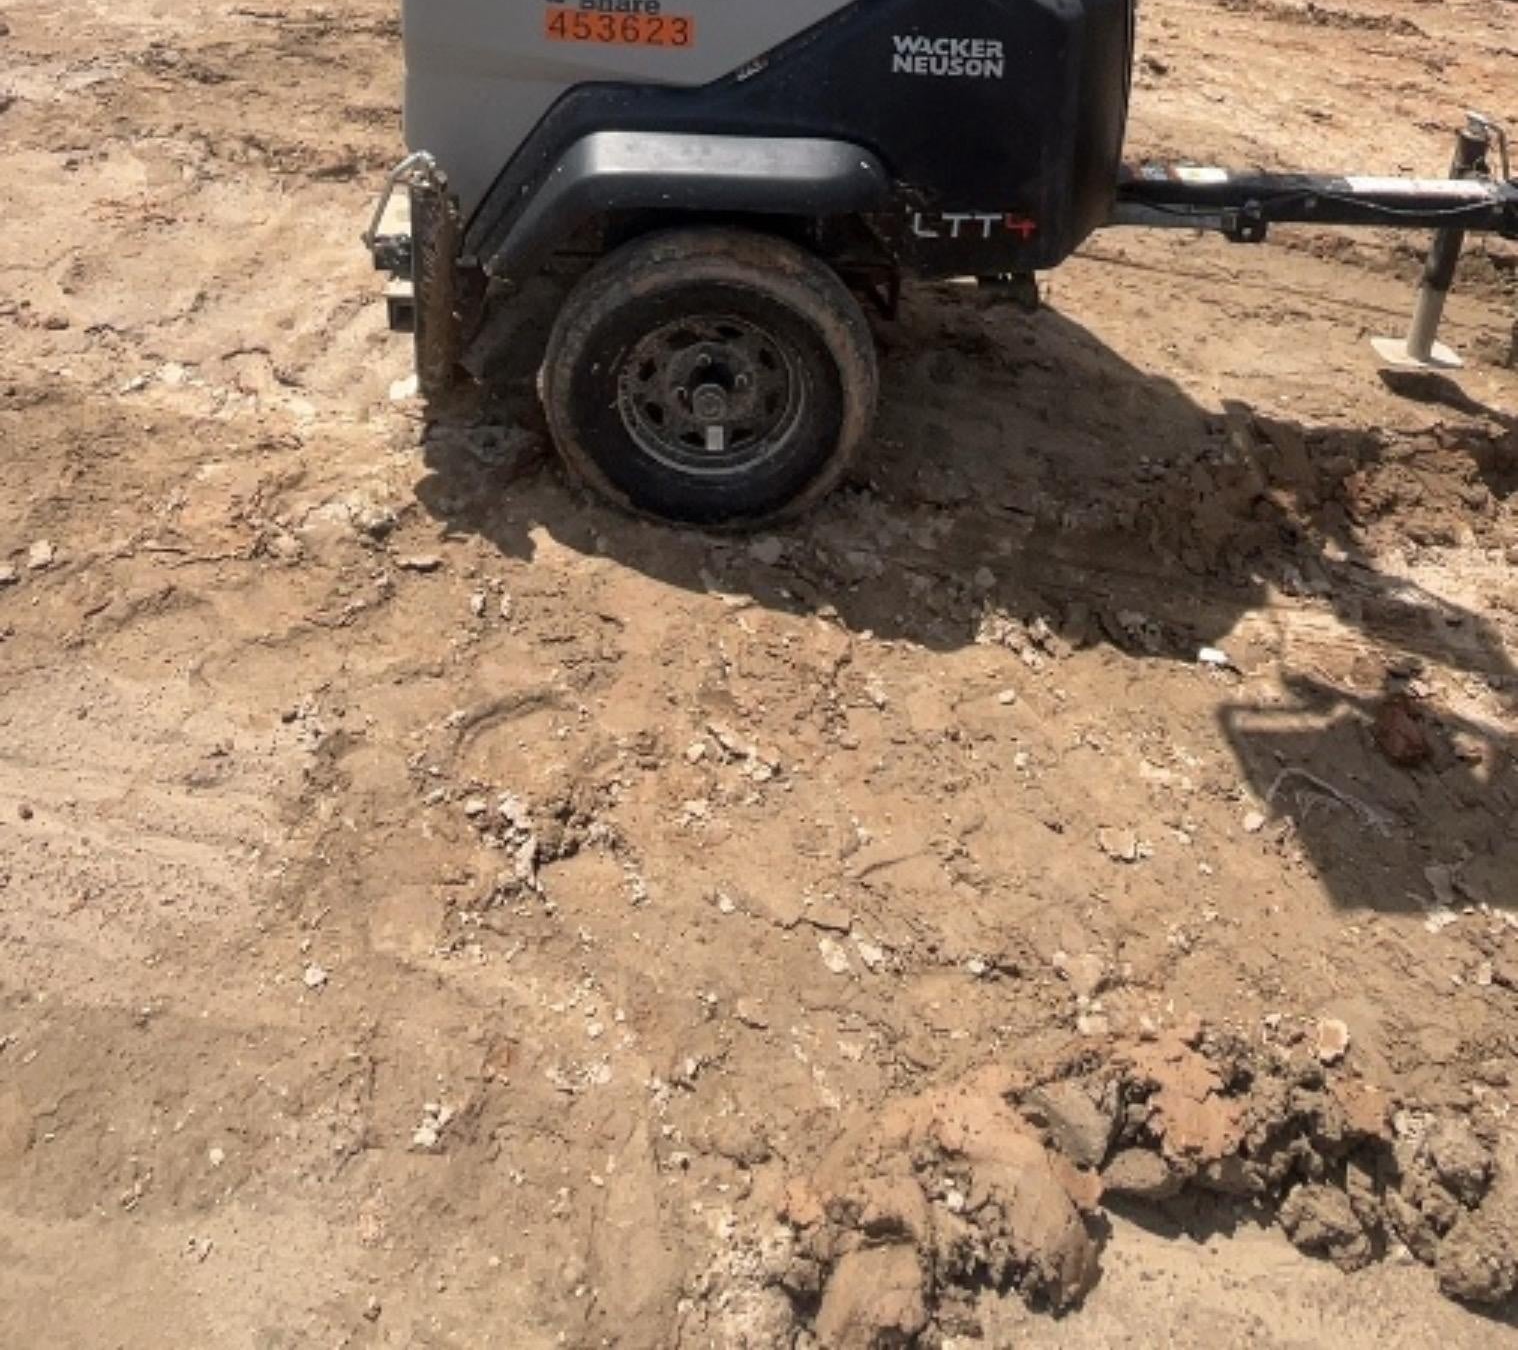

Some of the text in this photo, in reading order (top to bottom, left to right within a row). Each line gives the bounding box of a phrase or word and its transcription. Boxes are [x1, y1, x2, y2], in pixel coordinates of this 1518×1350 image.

[548, 11, 688, 47] 453623
[892, 35, 1005, 59] WACKER
[891, 53, 1005, 78] NEUSON
